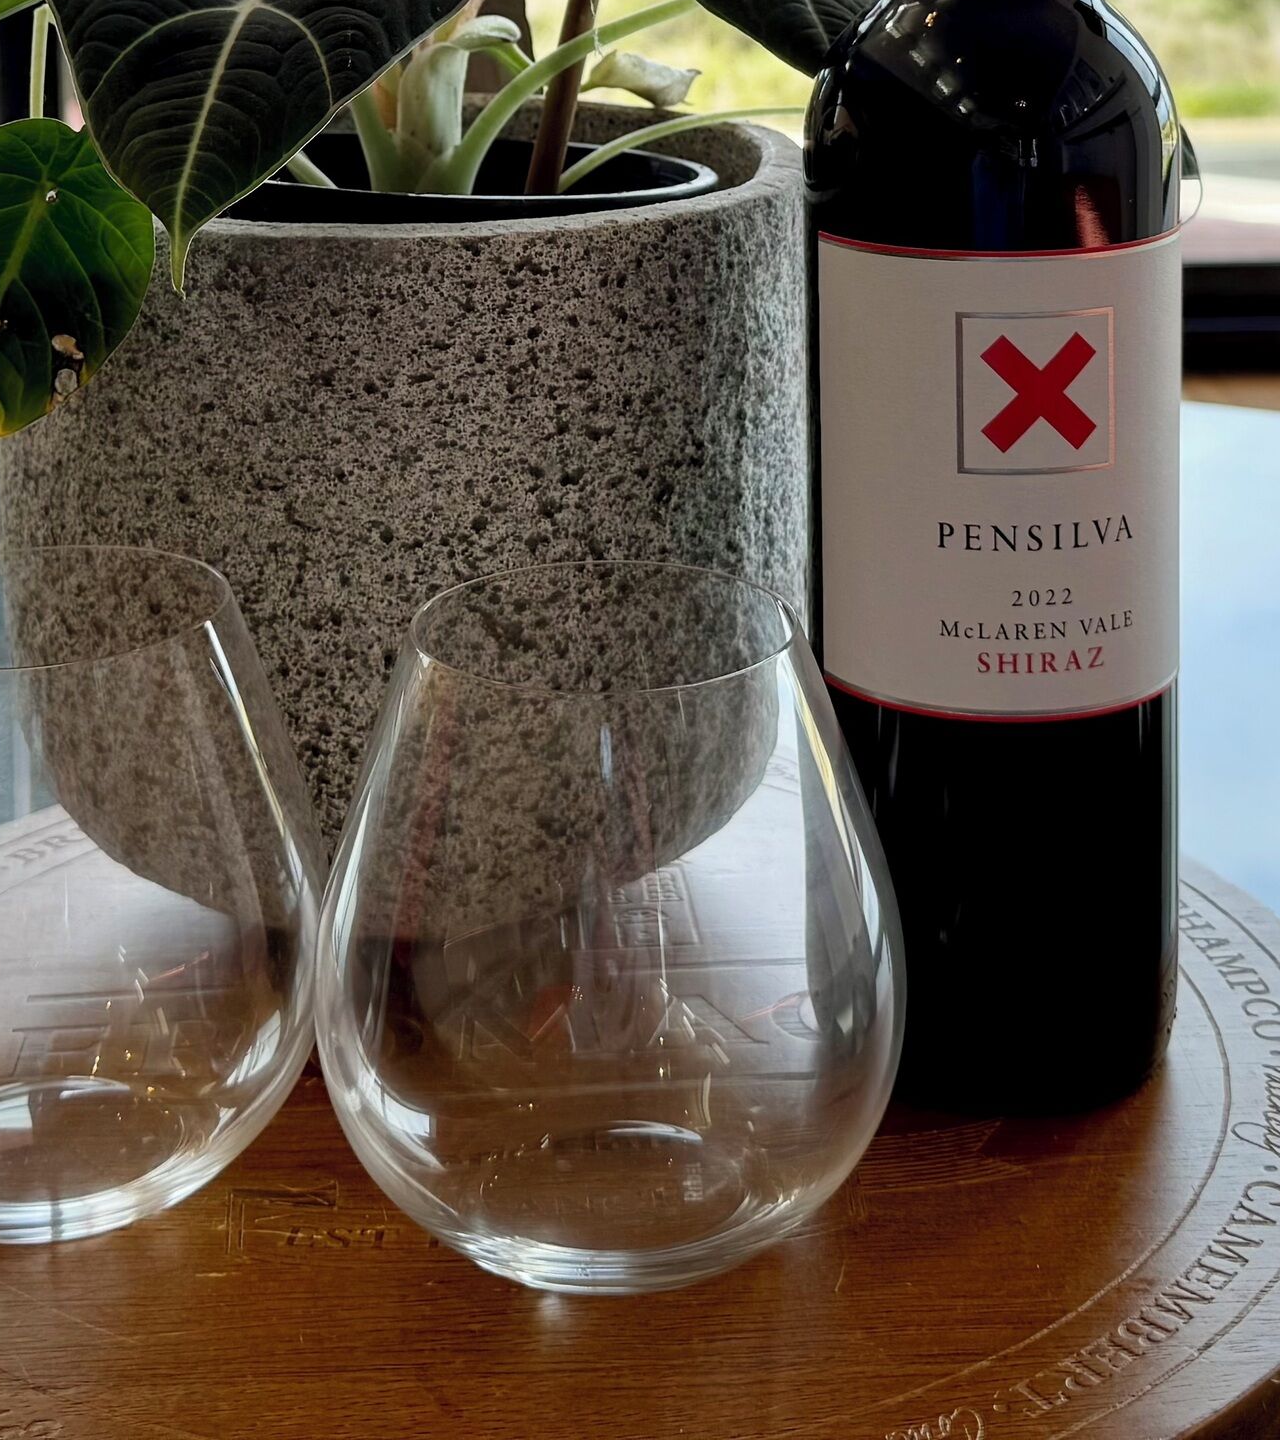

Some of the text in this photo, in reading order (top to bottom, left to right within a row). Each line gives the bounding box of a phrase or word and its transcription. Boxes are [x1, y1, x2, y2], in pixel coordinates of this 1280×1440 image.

[937, 513, 1134, 553] PENSILVA
[1012, 587, 1073, 608] 2022
[939, 609, 1133, 641] McLAREN VALE
[977, 645, 1104, 675] SHIRAZ
